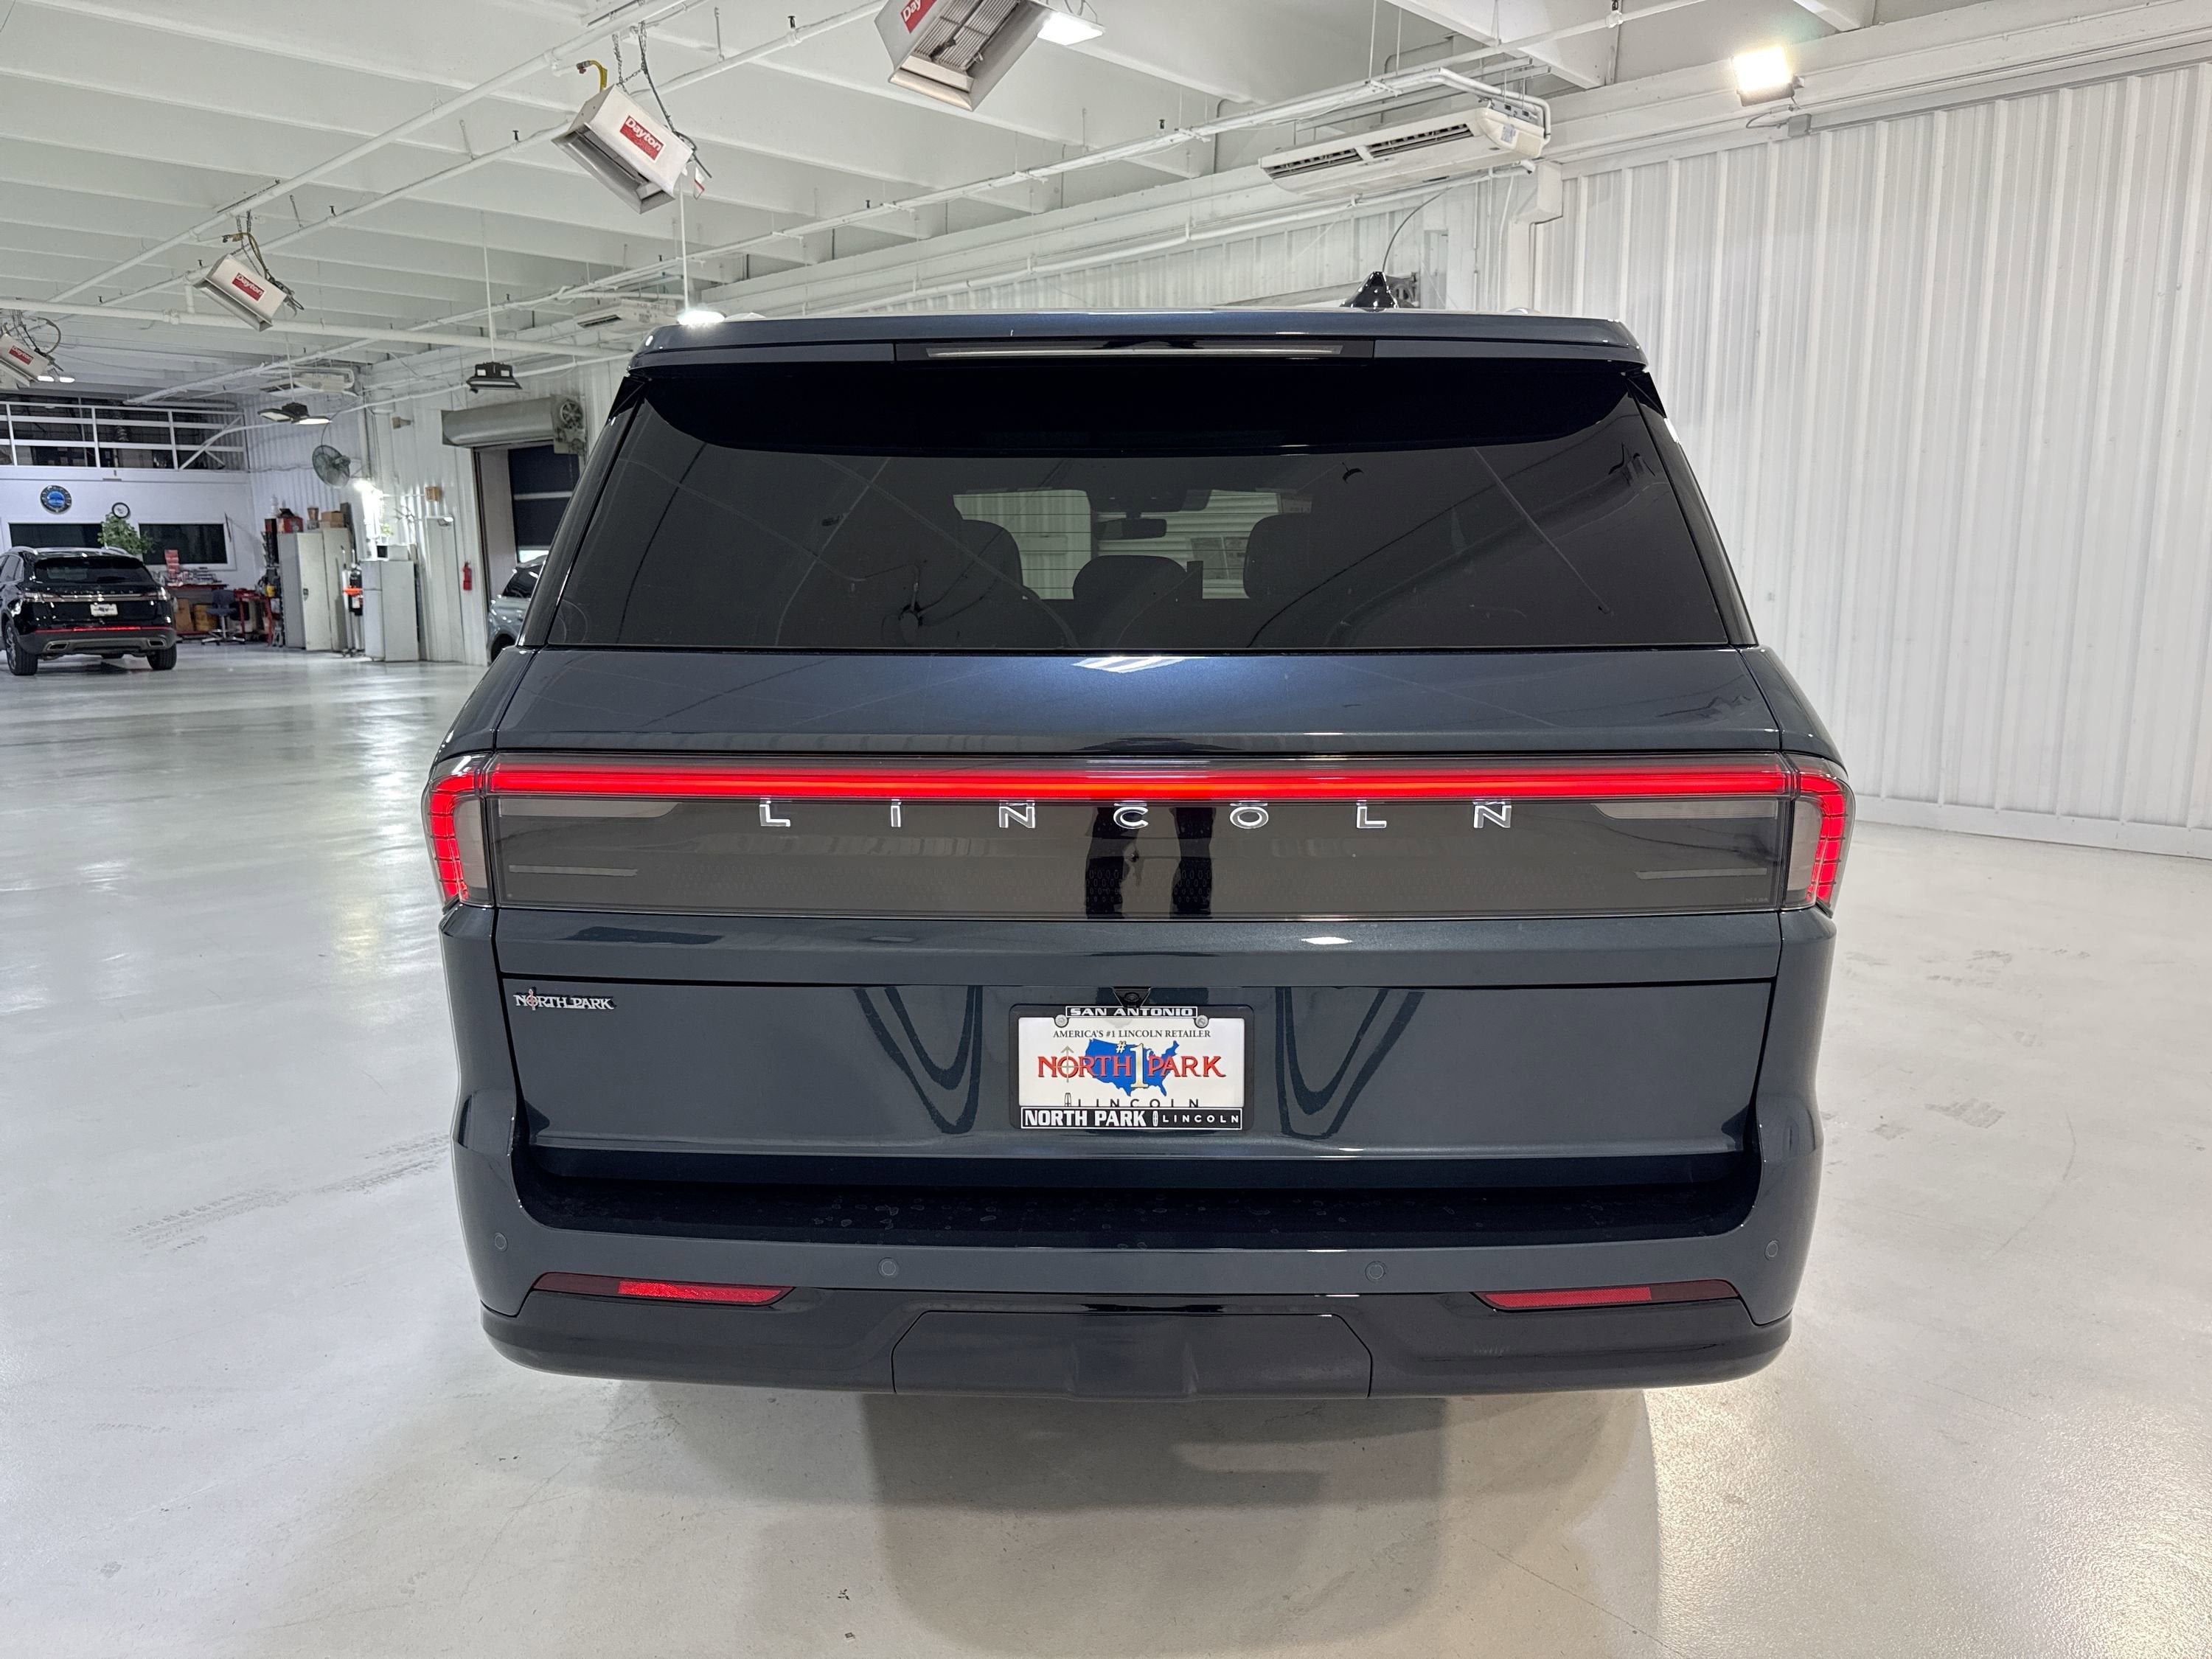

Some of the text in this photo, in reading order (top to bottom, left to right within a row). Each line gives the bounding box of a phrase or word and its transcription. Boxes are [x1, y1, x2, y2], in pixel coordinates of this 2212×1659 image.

[625, 117, 662, 152] Dayton
[236, 274, 264, 296] Dayton
[759, 802, 1512, 830] LINCOLN
[513, 993, 614, 1010] NORTH PARK
[1070, 1007, 1193, 1016] SAN ANTONIO
[1053, 1029, 1211, 1038] AMERICA'S #1 LINCOLN RETAILER
[1037, 1055, 1227, 1078] NORTH PARK
[1025, 1110, 1239, 1127] NORTH PARK LINCOLN
